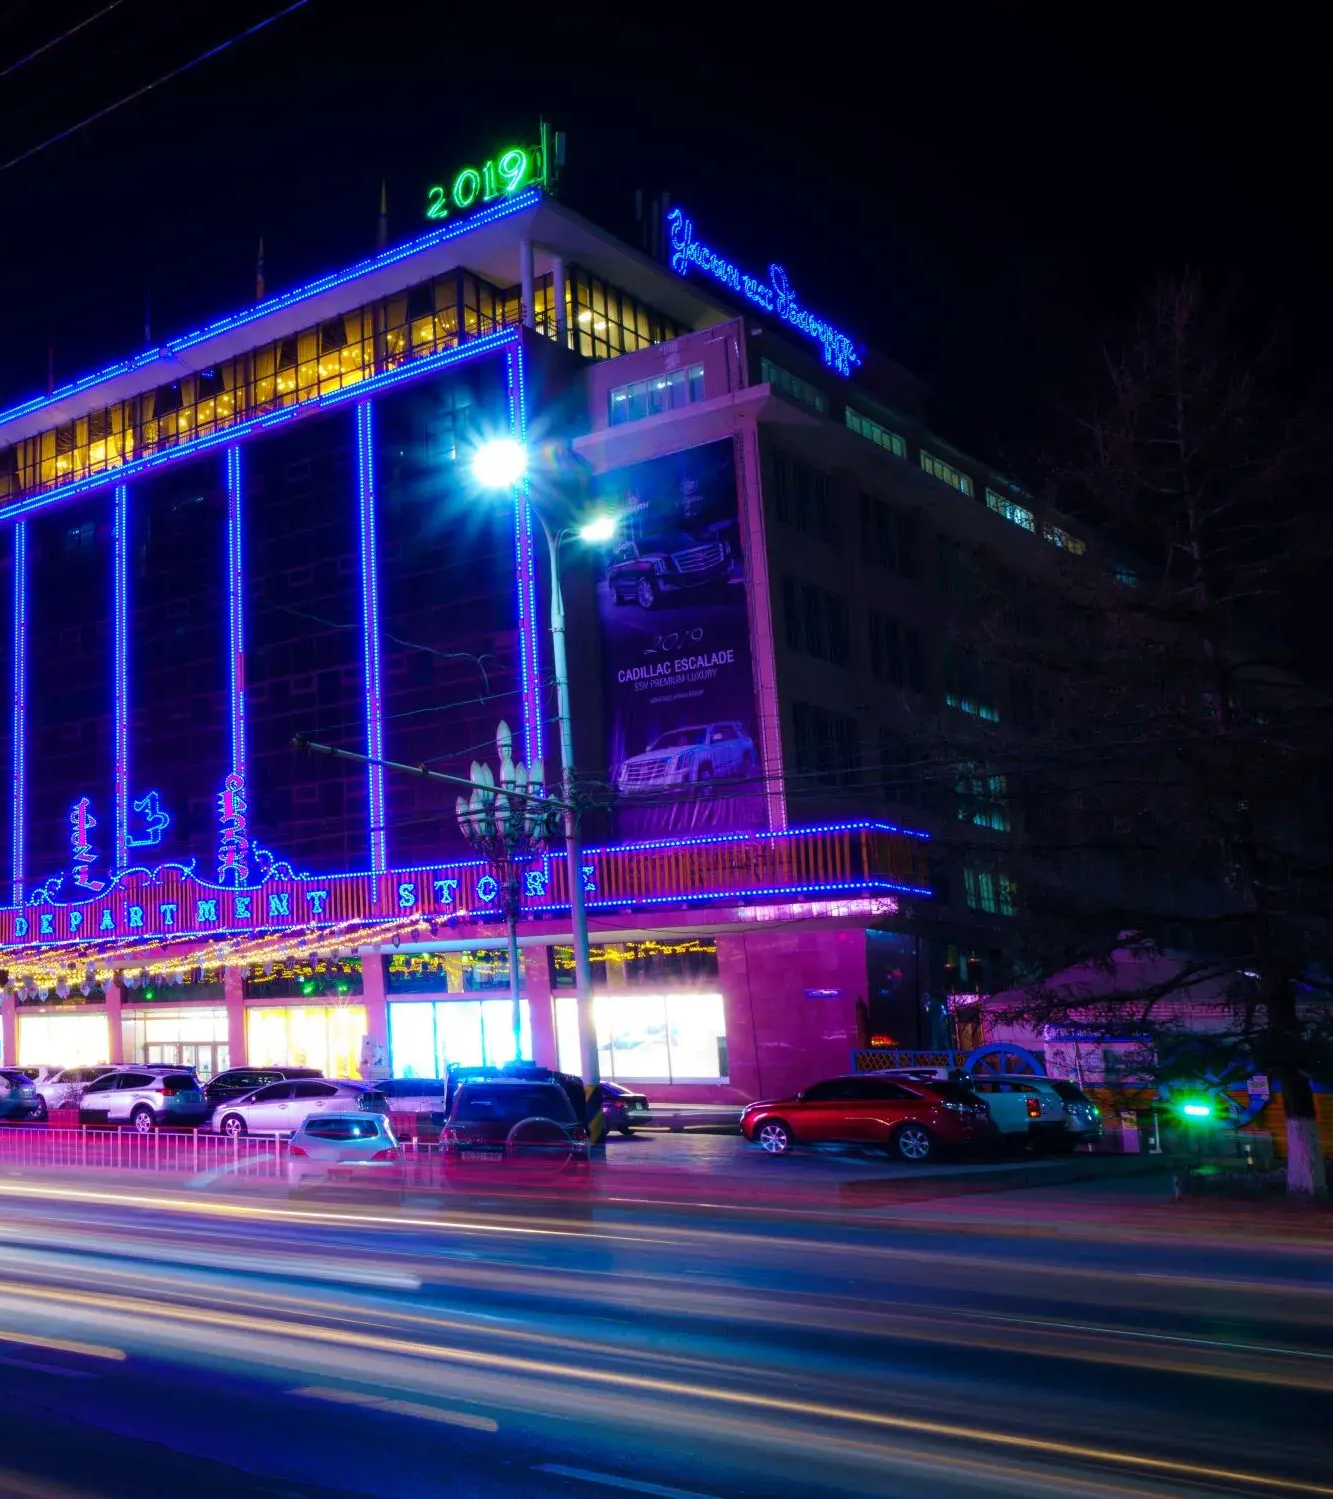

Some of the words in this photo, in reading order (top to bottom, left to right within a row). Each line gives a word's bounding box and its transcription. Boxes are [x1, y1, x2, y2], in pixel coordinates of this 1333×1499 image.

[426, 148, 530, 220] 2019
[617, 661, 672, 683] CADILLAC
[674, 649, 735, 672] ESCALADE
[650, 675, 685, 688] PREMIUM
[14, 891, 328, 937] DEPARTMENT
[398, 865, 595, 907] STORE
